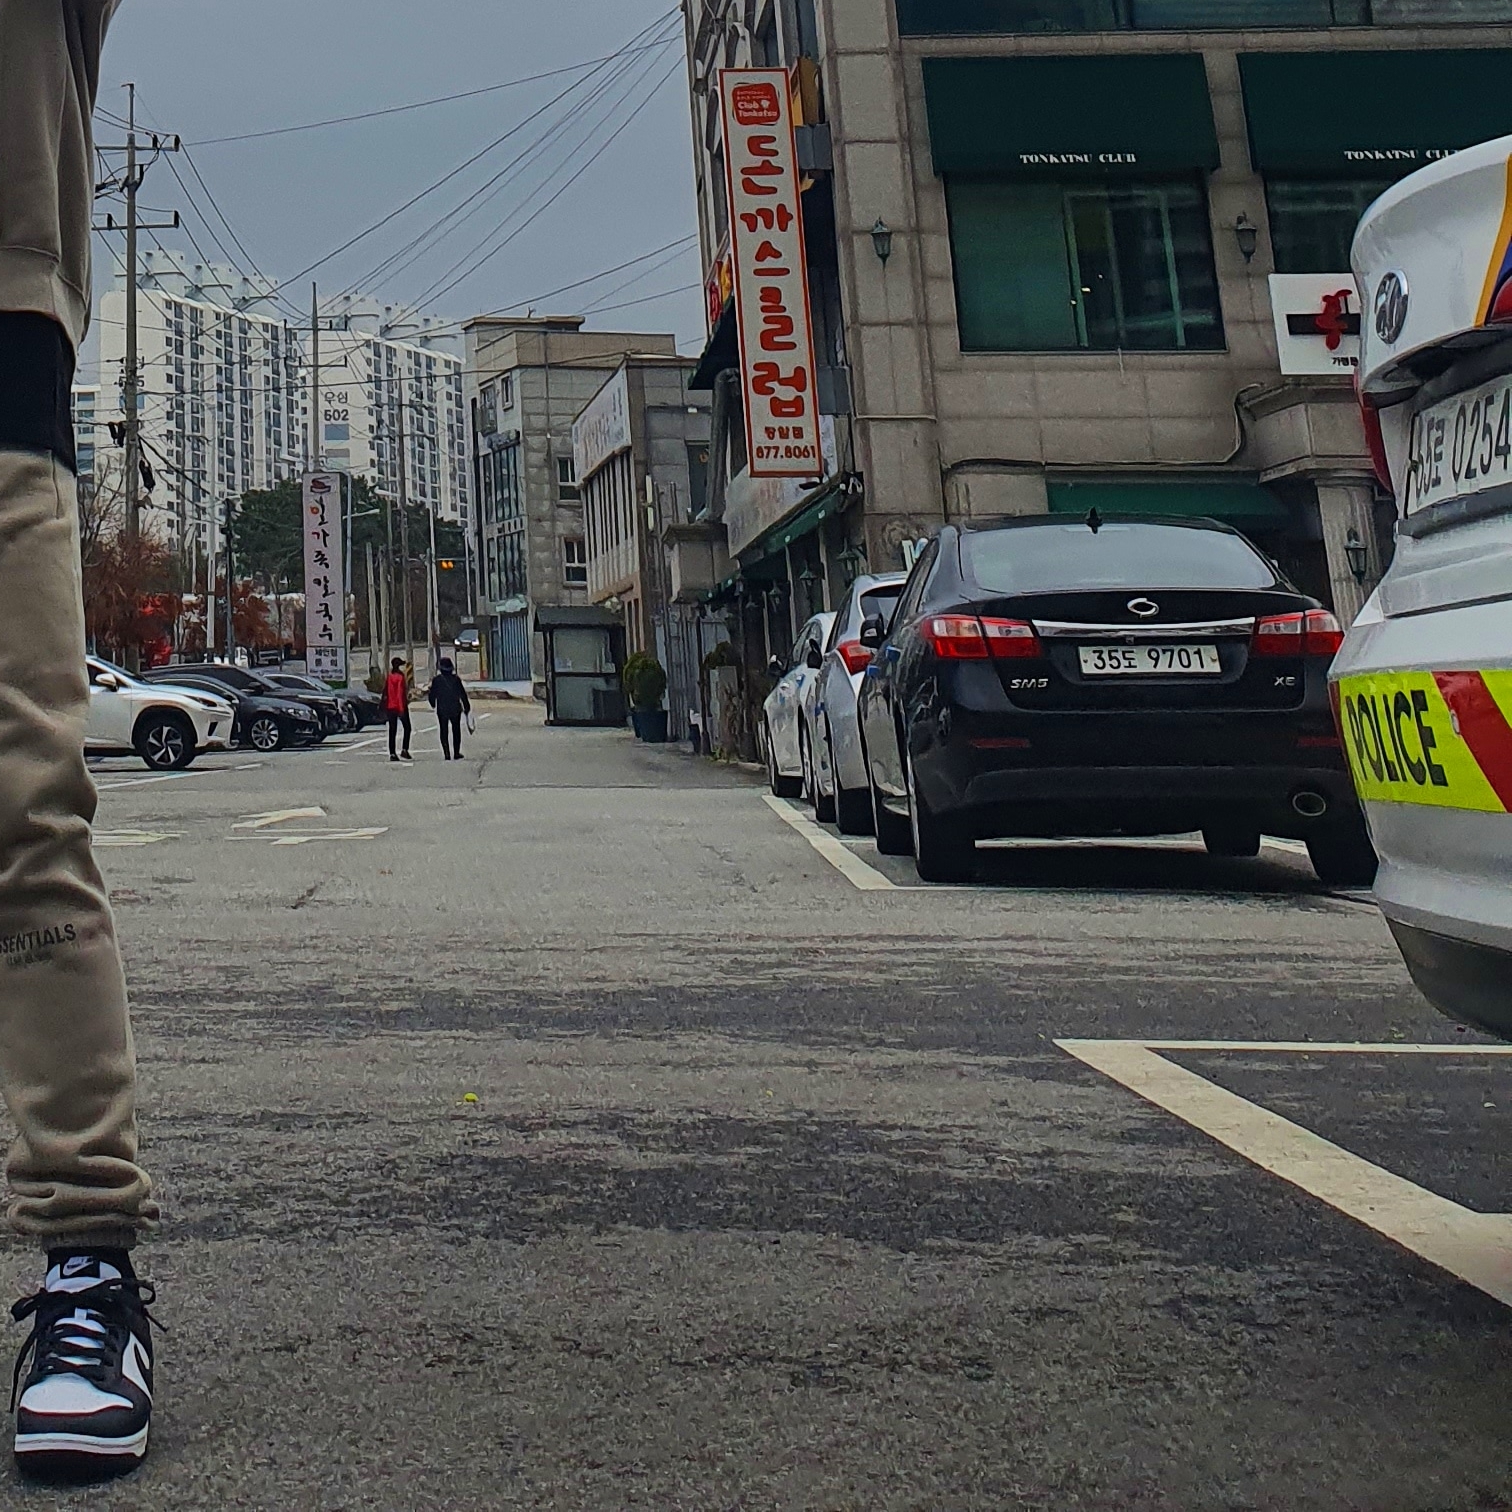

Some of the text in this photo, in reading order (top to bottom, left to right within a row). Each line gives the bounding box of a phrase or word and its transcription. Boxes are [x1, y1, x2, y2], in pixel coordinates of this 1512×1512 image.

[1019, 153, 1137, 164] TONKATSU CLUB
[1343, 149, 1419, 160] TONKATSU
[740, 134, 808, 418] 돈까스클럽
[1451, 388, 1511, 483] 0254
[1092, 647, 1205, 670] 35도 9701
[1010, 678, 1049, 689] SM5
[1273, 676, 1296, 686] XE
[1344, 689, 1449, 787] POLICE
